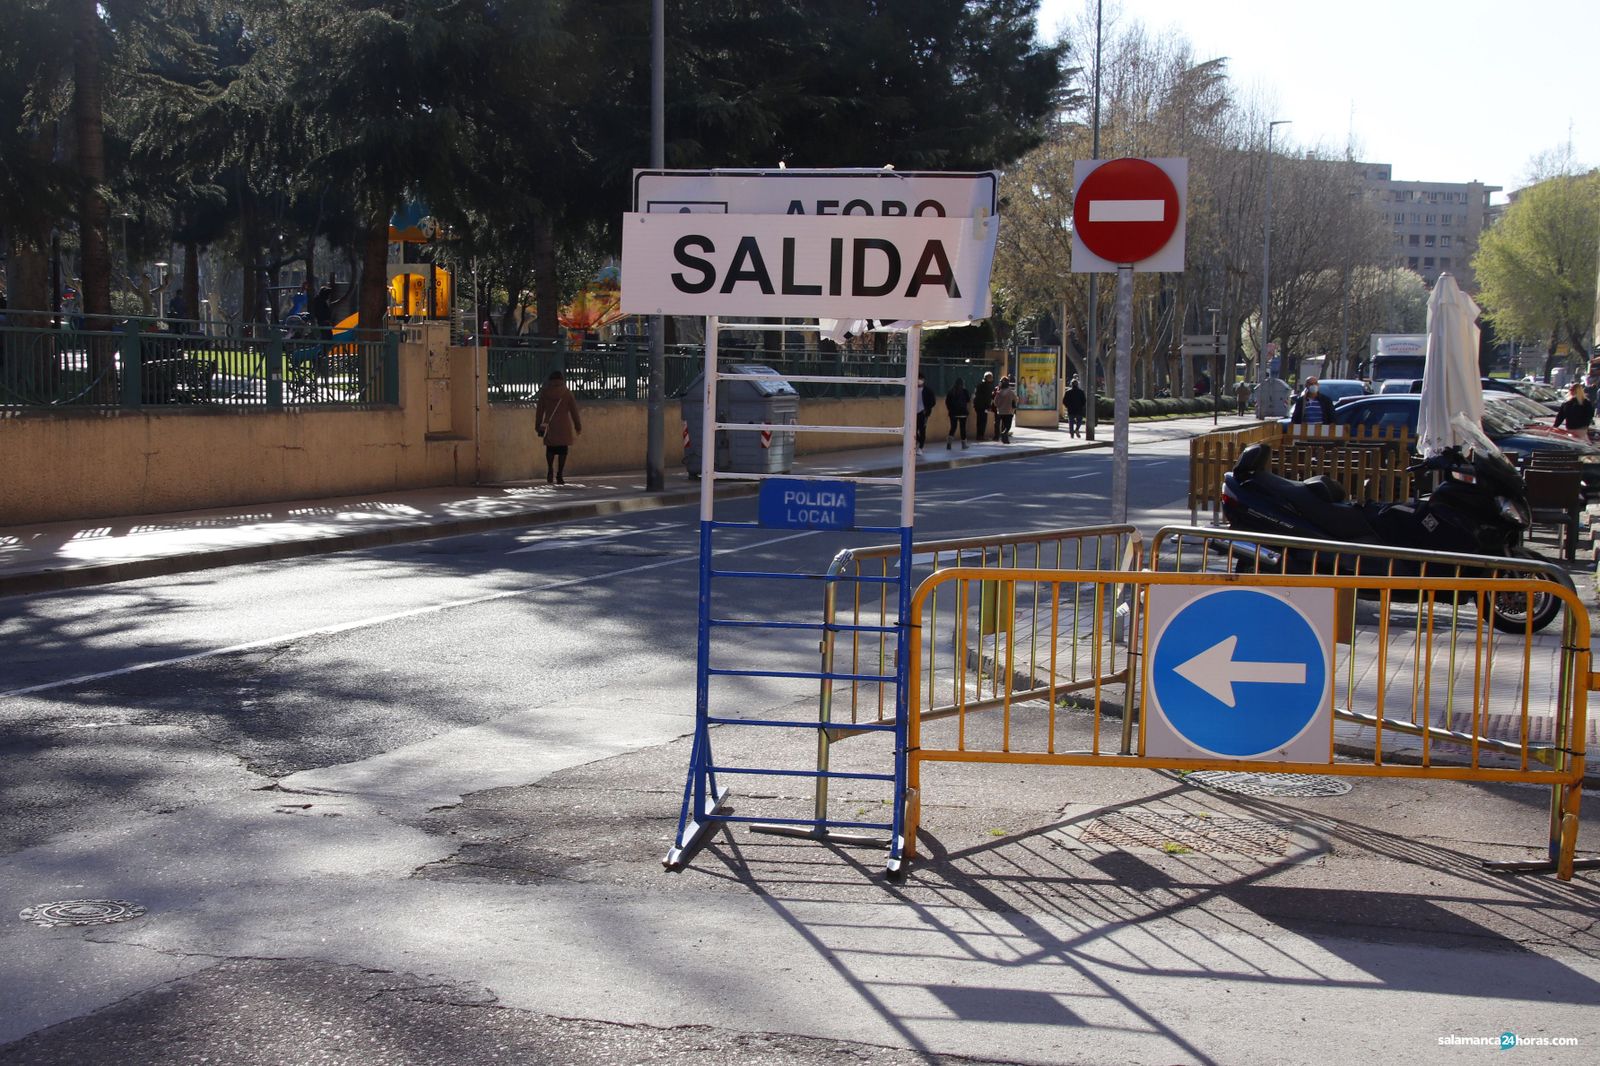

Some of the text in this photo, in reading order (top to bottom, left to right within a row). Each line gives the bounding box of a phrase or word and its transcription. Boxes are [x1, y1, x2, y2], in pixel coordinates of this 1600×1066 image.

[671, 234, 962, 299] SALIDA
[784, 490, 847, 508] POLICIA
[787, 508, 839, 525] LOCAL
